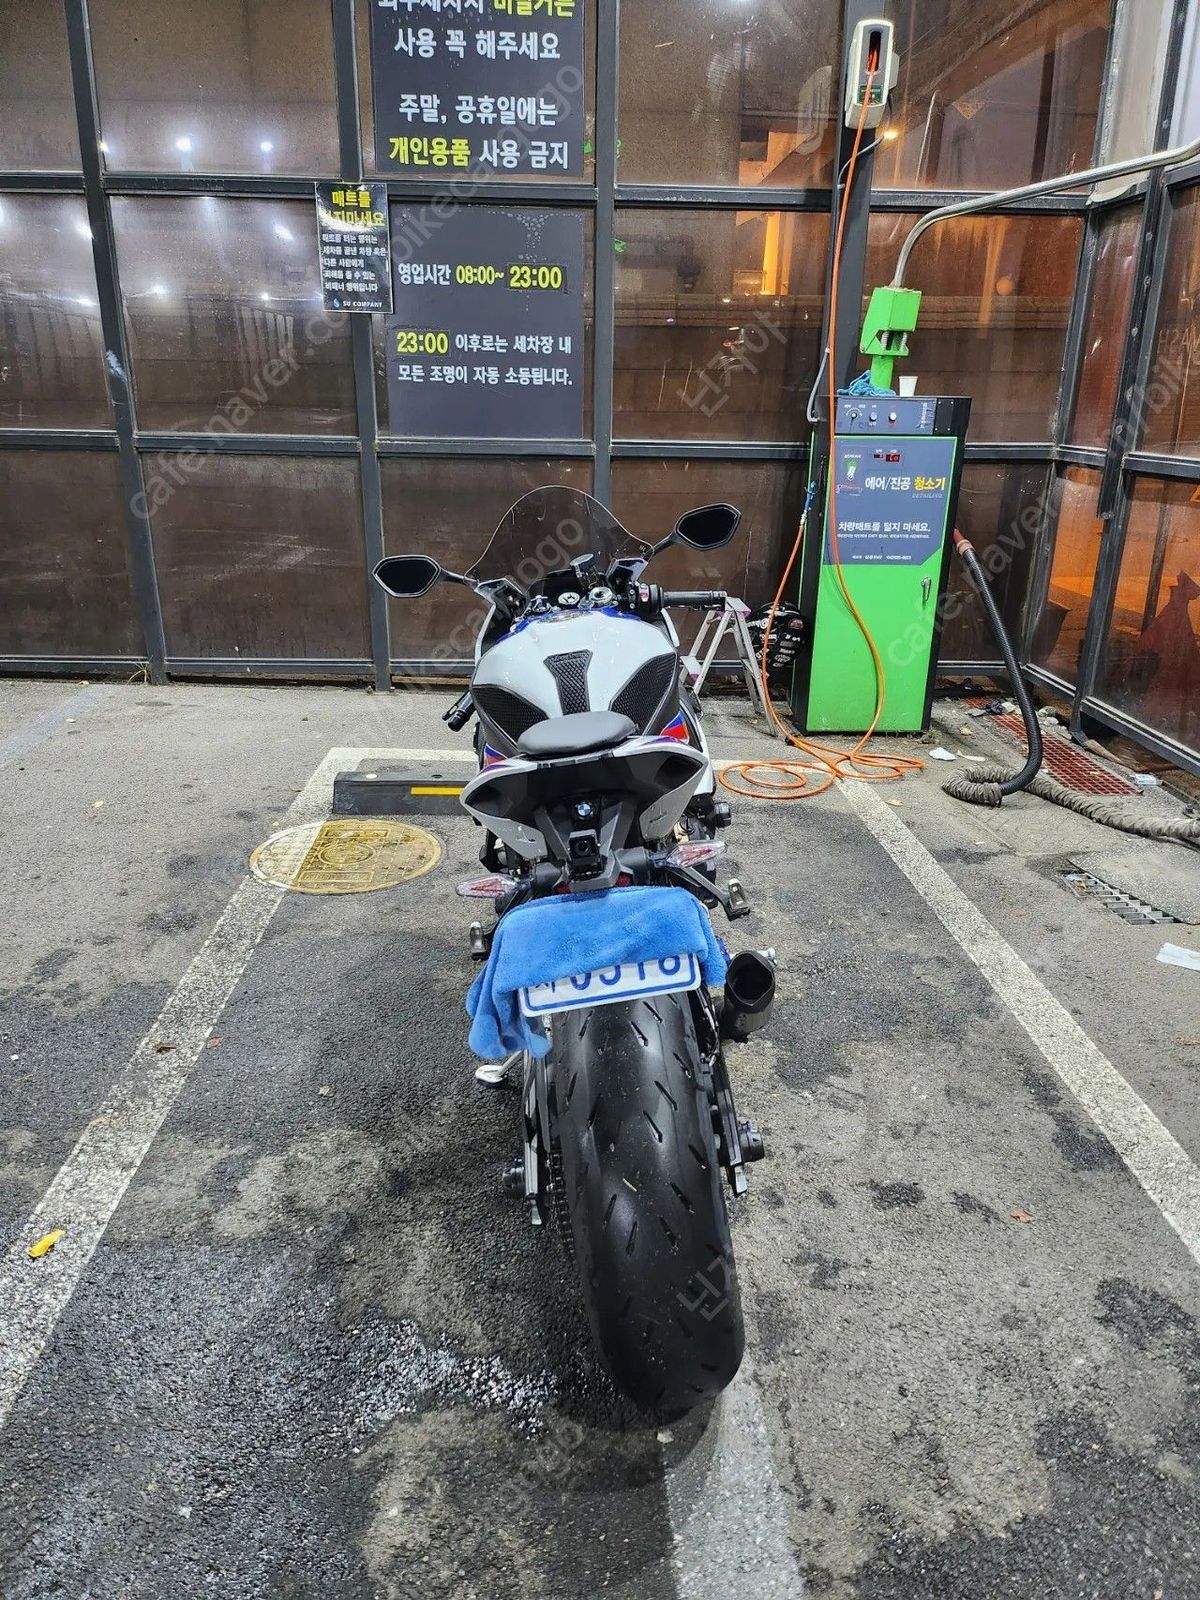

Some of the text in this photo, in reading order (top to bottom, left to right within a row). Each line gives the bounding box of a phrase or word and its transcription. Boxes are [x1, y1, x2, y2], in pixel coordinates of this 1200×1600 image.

[394, 28, 560, 60] 사용 꼭 해주세요
[399, 94, 558, 126] 주말, 공휴일에는
[389, 137, 568, 169] 개인용품 사용 금지
[332, 190, 371, 207] 매트를
[398, 263, 562, 288] 영업시간 08:00~ 23:00
[396, 331, 572, 354] 23:00 이후로는 세차장 내
[398, 365, 573, 385] 모든 조명이 자동 소등됩니다.
[865, 476, 946, 491] 에어/진공 청소기
[838, 521, 931, 533] 차량매트를 털지 마세요.
